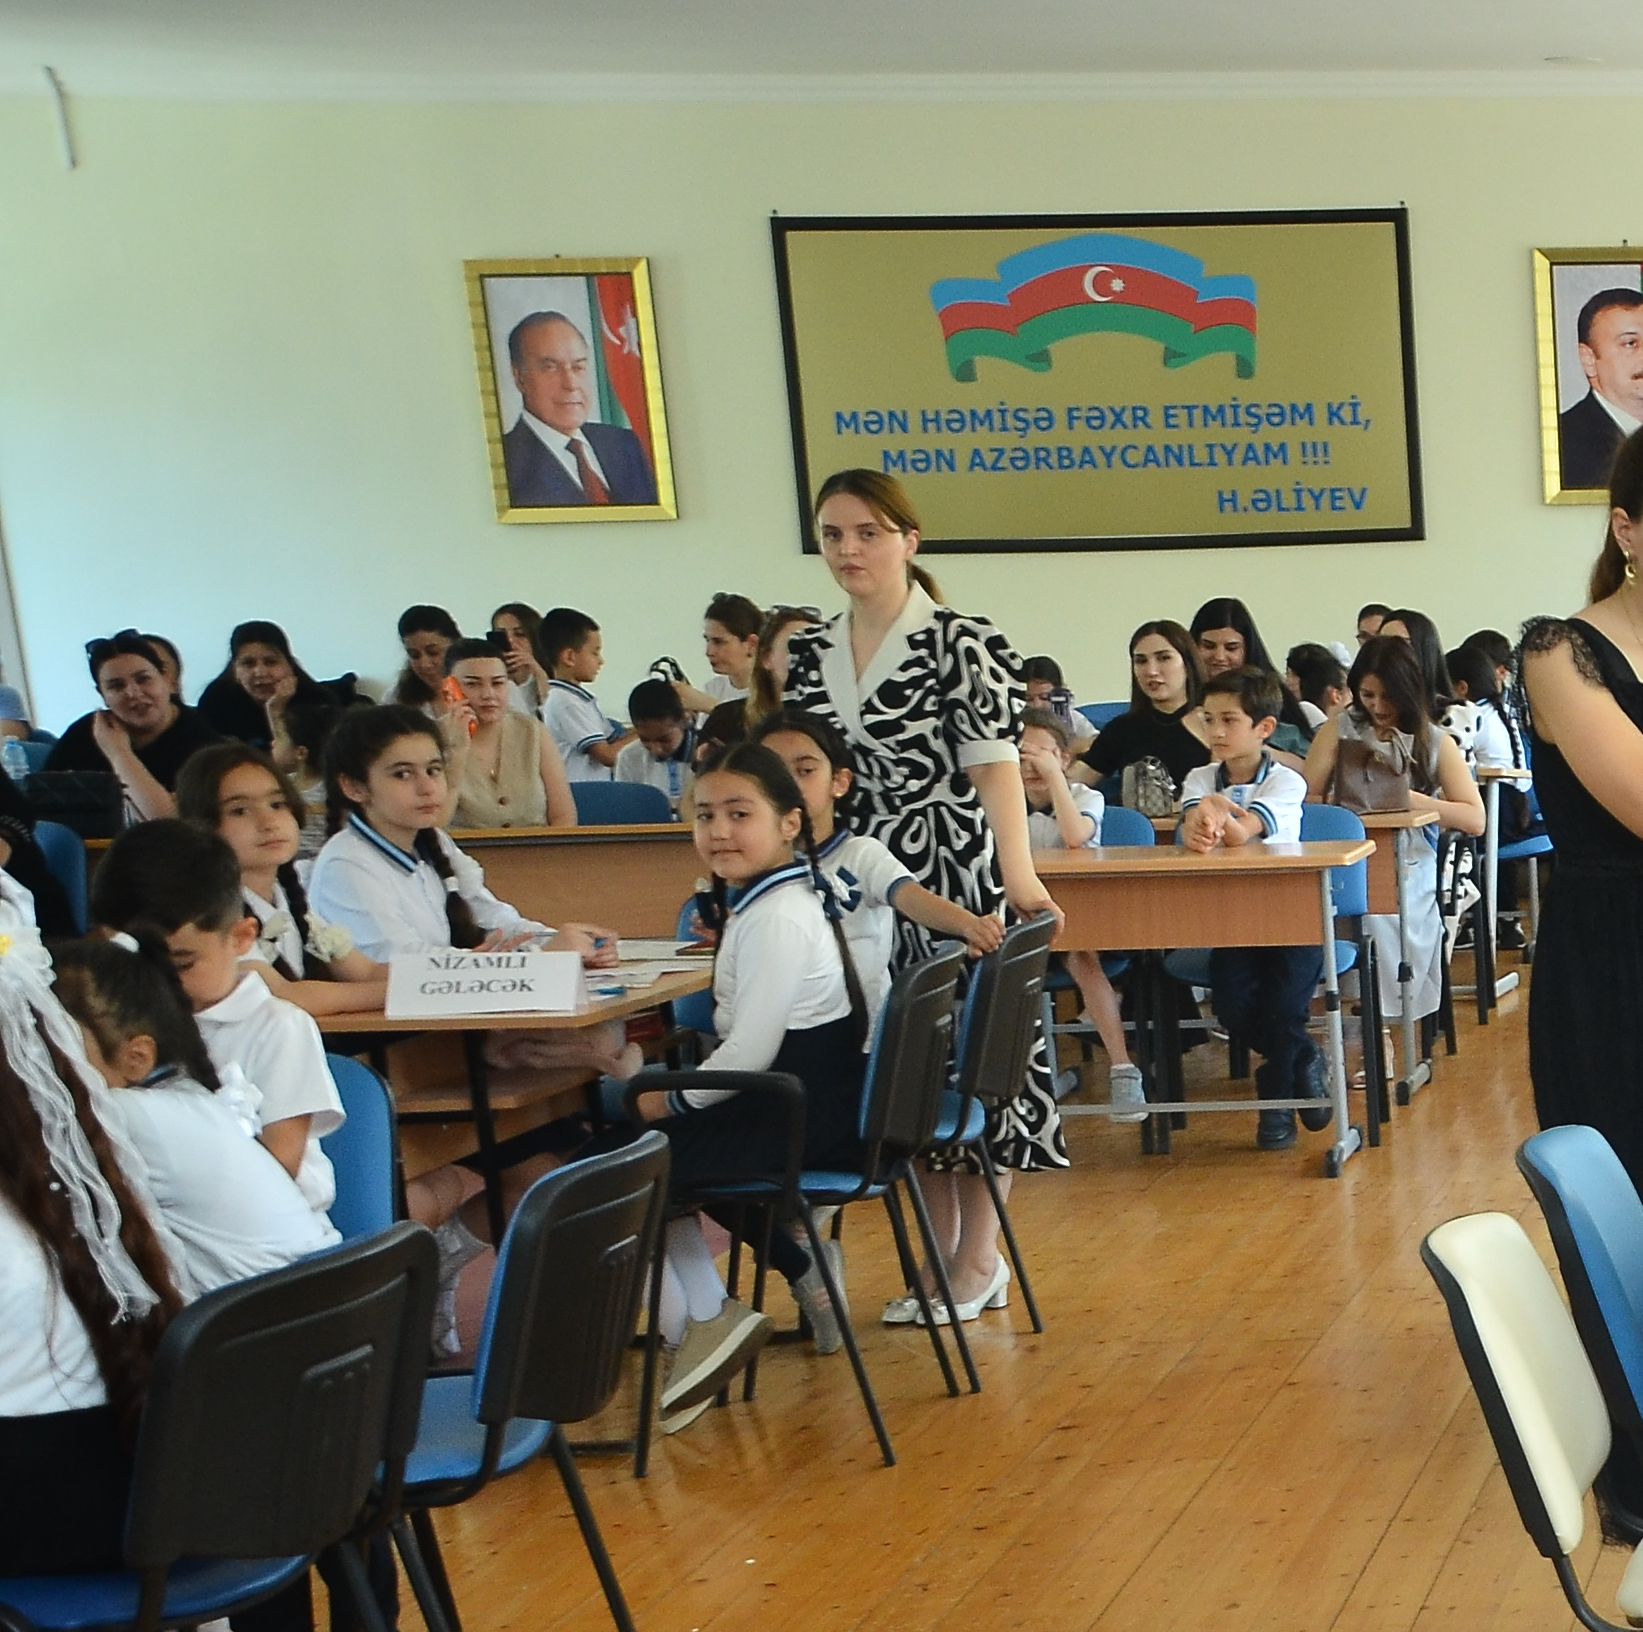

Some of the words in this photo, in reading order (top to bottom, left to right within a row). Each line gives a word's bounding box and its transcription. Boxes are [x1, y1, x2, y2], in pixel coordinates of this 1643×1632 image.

[834, 409, 909, 436] MƏN
[921, 400, 1055, 438] HƏMİŞƏ
[1066, 406, 1152, 432] FƏXR
[1164, 396, 1315, 434] ETMİŞƏM
[1327, 394, 1373, 432] Kİ,
[882, 448, 958, 475] MƏN
[967, 440, 1290, 473] AZƏRBAYCANLIYAM
[1300, 441, 1332, 467] !!!
[1217, 480, 1368, 514] H.ƏLİYEV
[427, 955, 527, 971] NİZAMLI
[420, 978, 535, 996] GƏLƏCƏK
